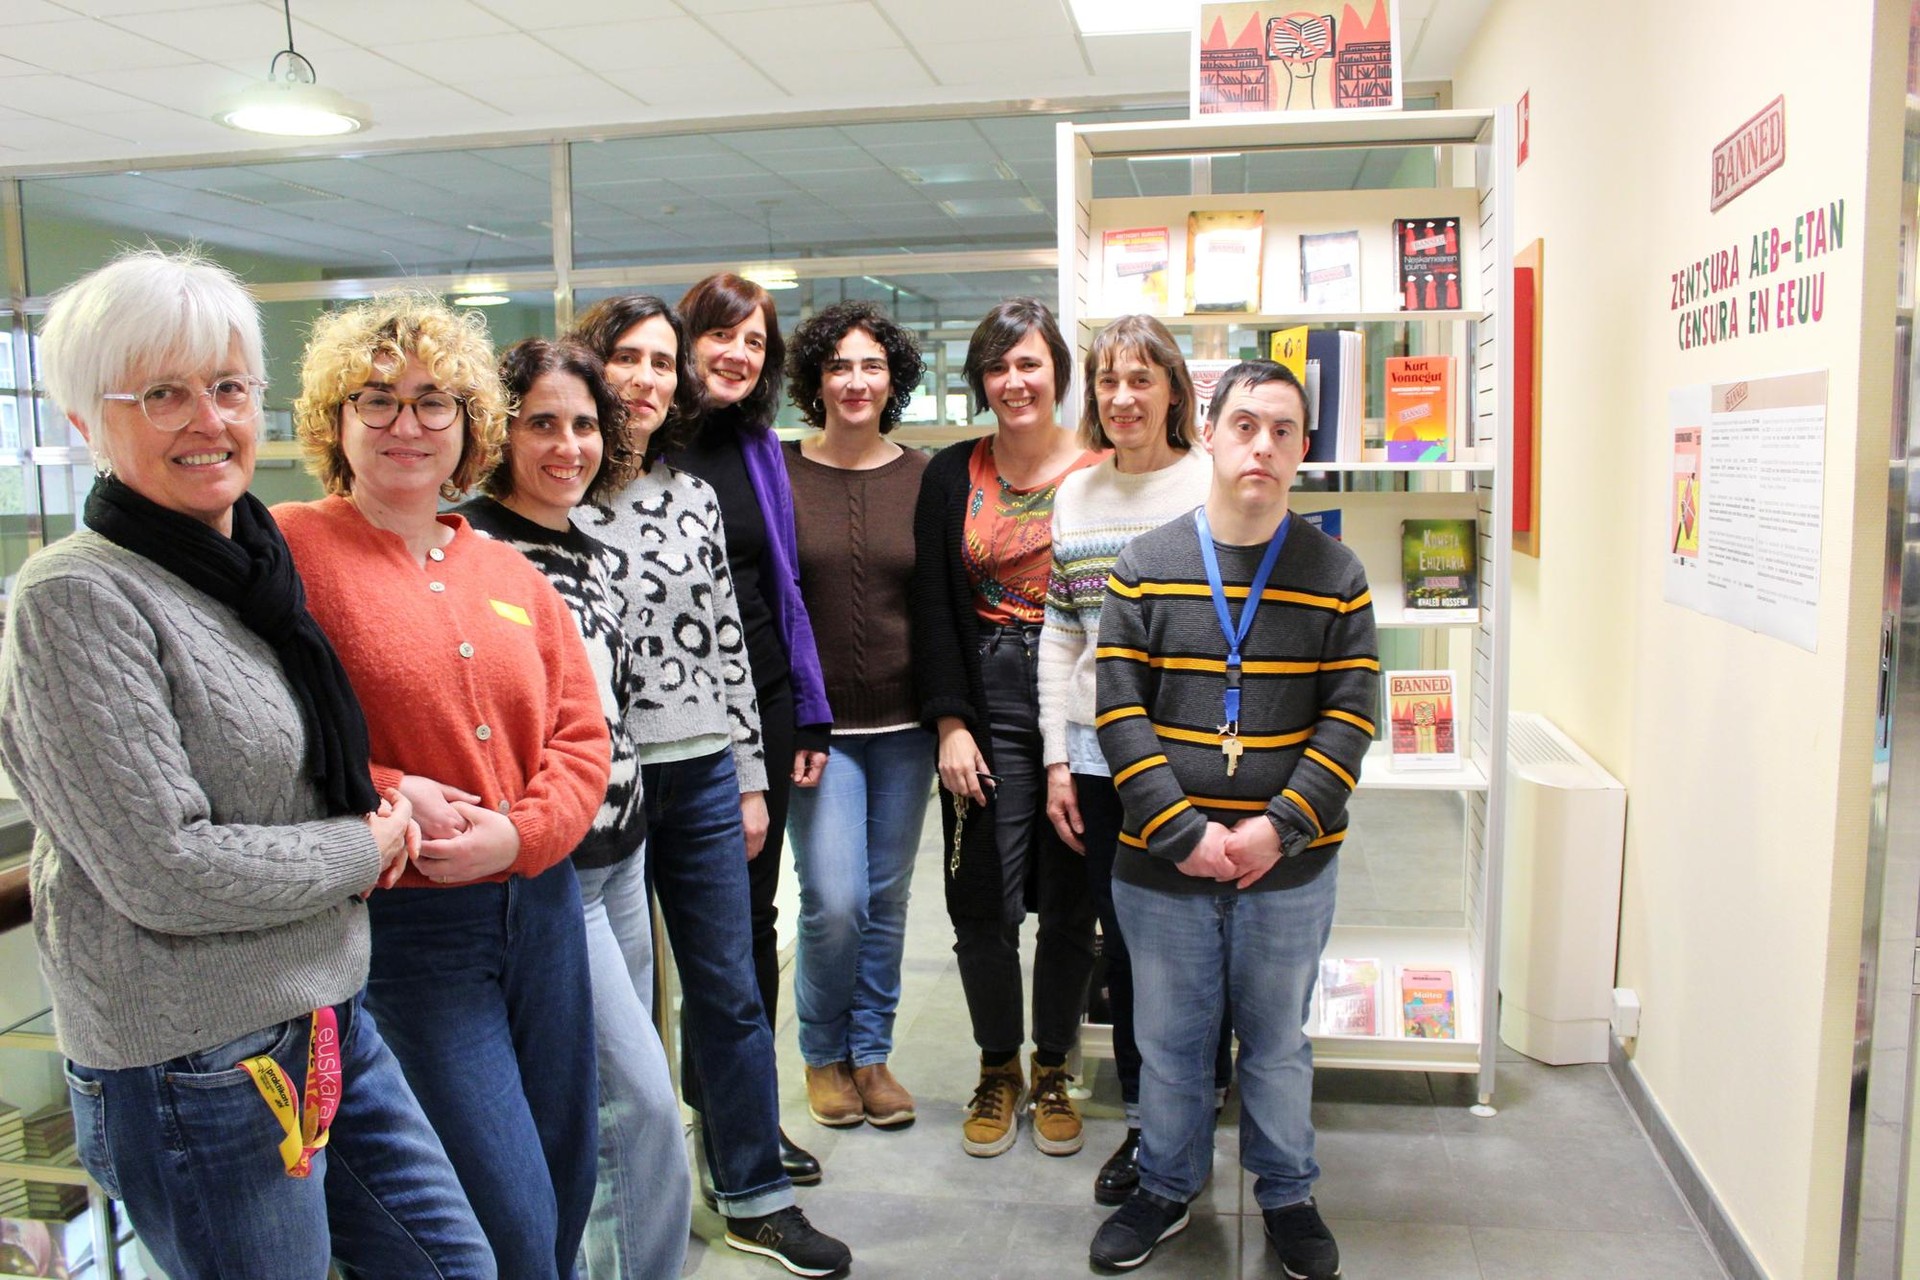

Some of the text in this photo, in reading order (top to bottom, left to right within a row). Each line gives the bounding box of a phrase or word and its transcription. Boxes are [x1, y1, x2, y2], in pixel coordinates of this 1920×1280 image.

[1713, 109, 1783, 199] BANNED
[1414, 236, 1445, 250] BANNED
[1403, 255, 1457, 264] Neskamearen
[1671, 199, 1845, 310] ZENTSURA AEB-ETAN
[1678, 271, 1826, 351] CENSURA EN EEUU
[1404, 360, 1429, 372] Kurt
[1391, 372, 1442, 384] Vonnegut
[1423, 529, 1460, 548] KOMETA
[1419, 552, 1467, 571] EHIZTARIA
[1418, 597, 1469, 607] KHALED HOSSEINI
[1393, 678, 1449, 693] BANNED
[318, 1027, 342, 1119] euskara
[266, 1068, 290, 1107] praktikatu
